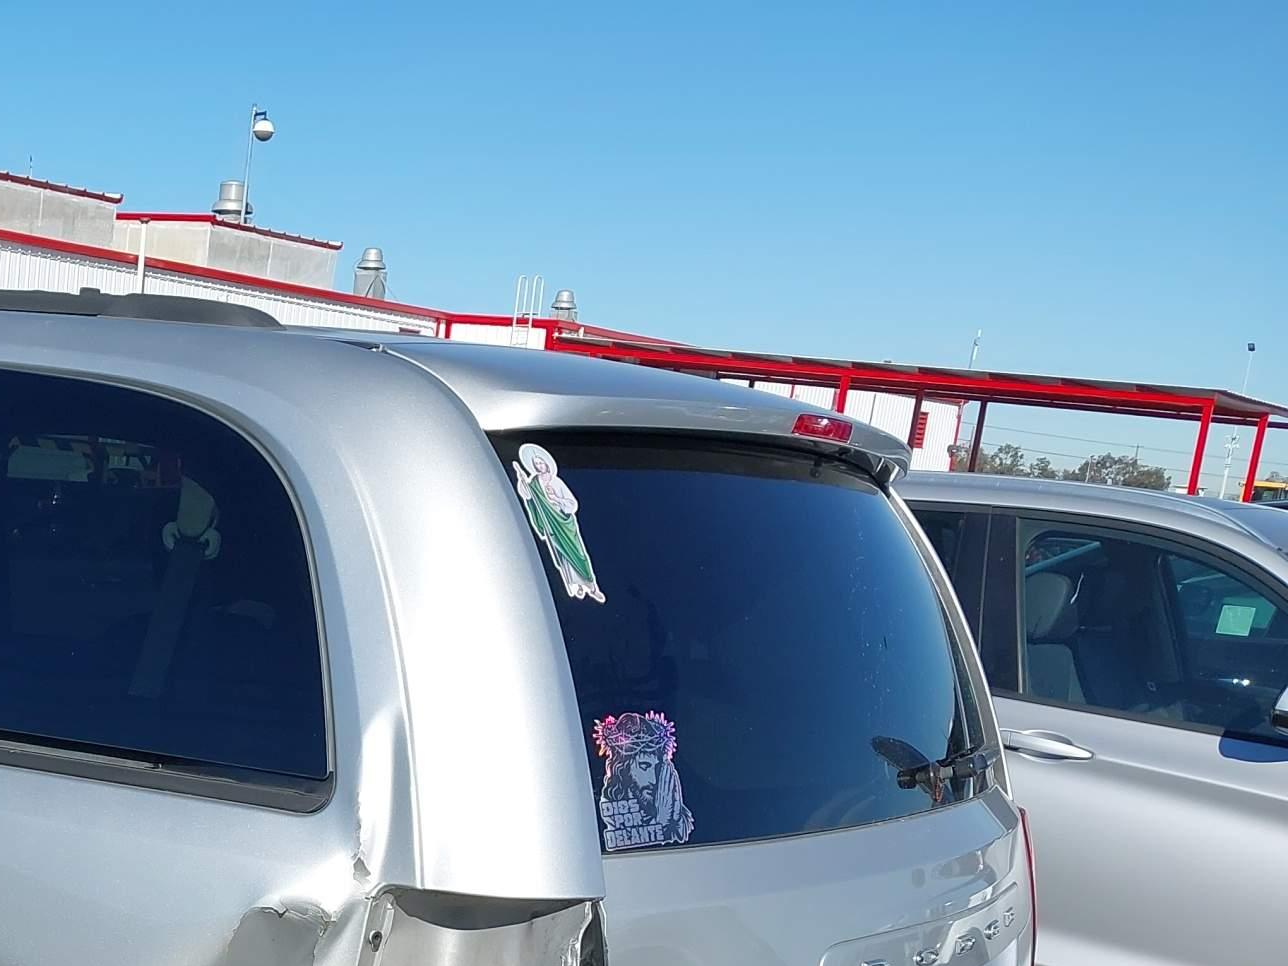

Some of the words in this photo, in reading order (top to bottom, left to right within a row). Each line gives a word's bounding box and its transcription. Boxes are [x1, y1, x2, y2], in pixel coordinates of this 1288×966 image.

[601, 799, 640, 817] DIOS
[614, 812, 643, 829] POR
[605, 824, 665, 848] DELANTE
